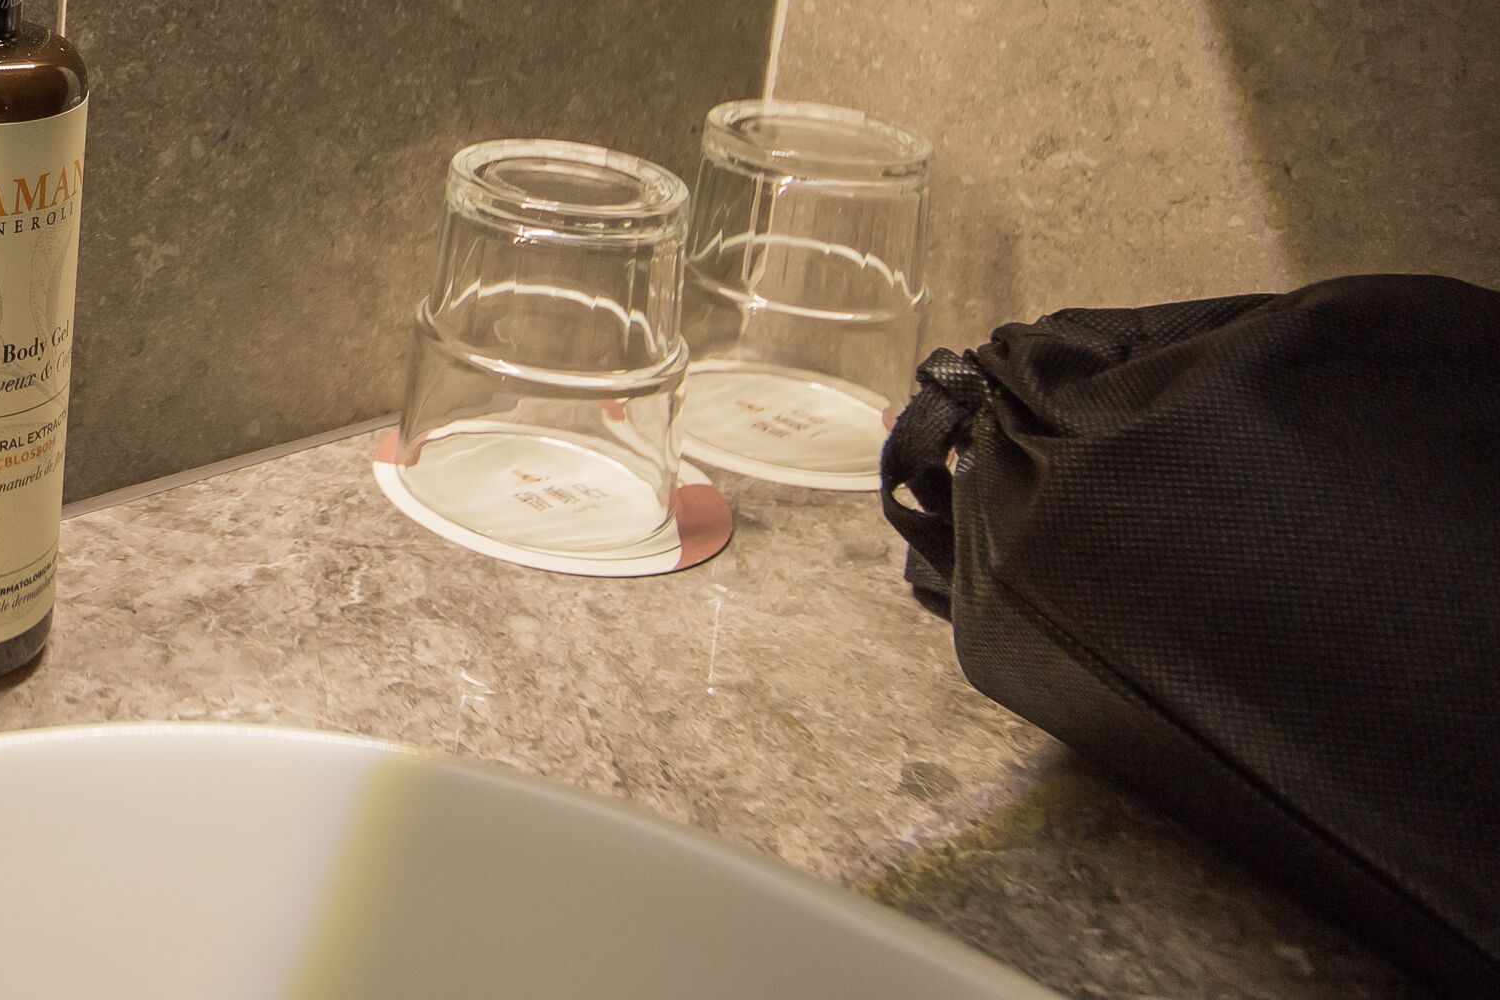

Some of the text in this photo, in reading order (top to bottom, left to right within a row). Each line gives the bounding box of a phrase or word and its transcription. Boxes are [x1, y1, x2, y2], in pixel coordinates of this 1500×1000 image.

[3, 337, 47, 364] Body
[52, 319, 70, 347] Gel
[40, 360, 53, 382] &
[4, 437, 56, 467] BLOSSOM
